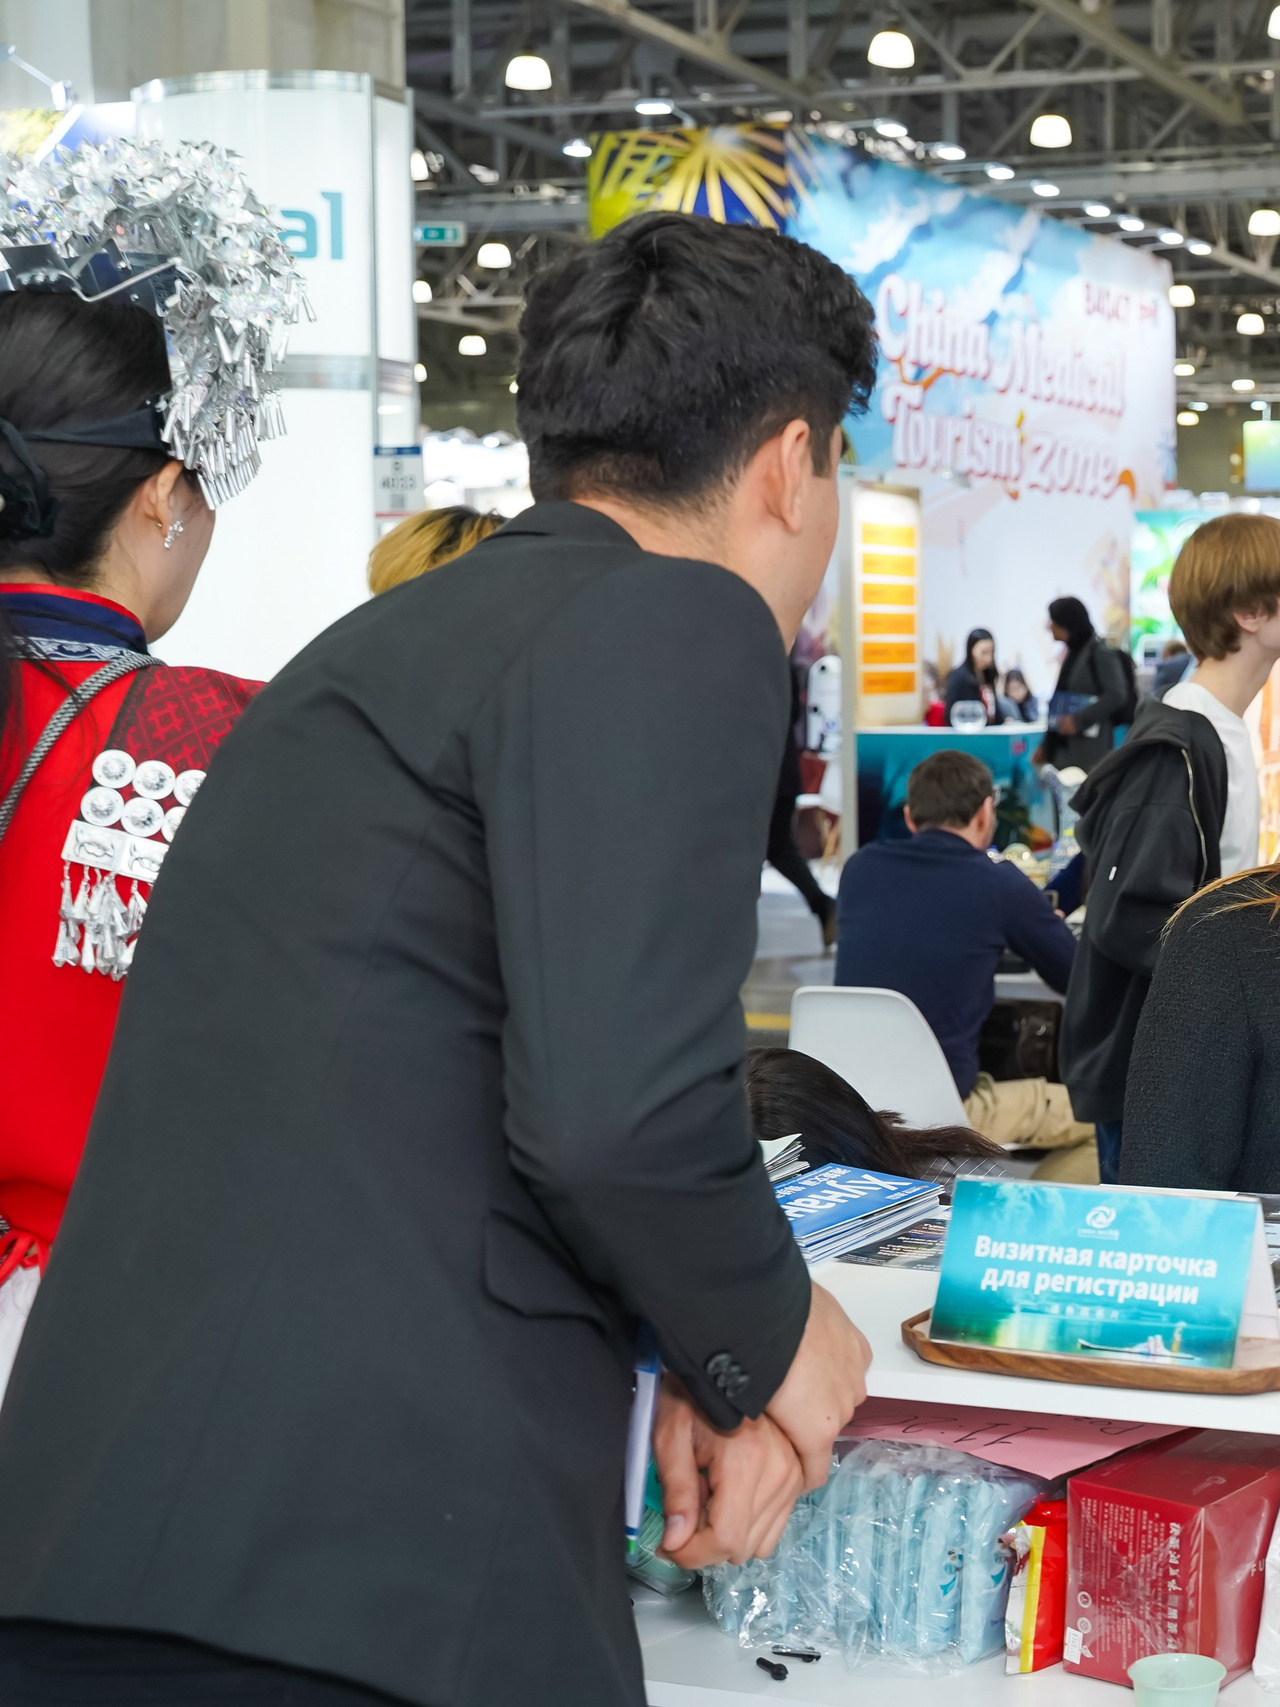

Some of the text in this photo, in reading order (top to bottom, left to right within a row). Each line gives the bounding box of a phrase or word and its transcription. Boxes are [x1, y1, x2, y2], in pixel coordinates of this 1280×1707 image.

[877, 273, 1126, 417] China Medical
[880, 382, 1120, 500] Tourism zone
[780, 1174, 913, 1221] Хунан
[974, 1234, 1093, 1269] Визитная
[1098, 1249, 1219, 1279] карточка
[980, 1264, 1200, 1308] для регистрации
